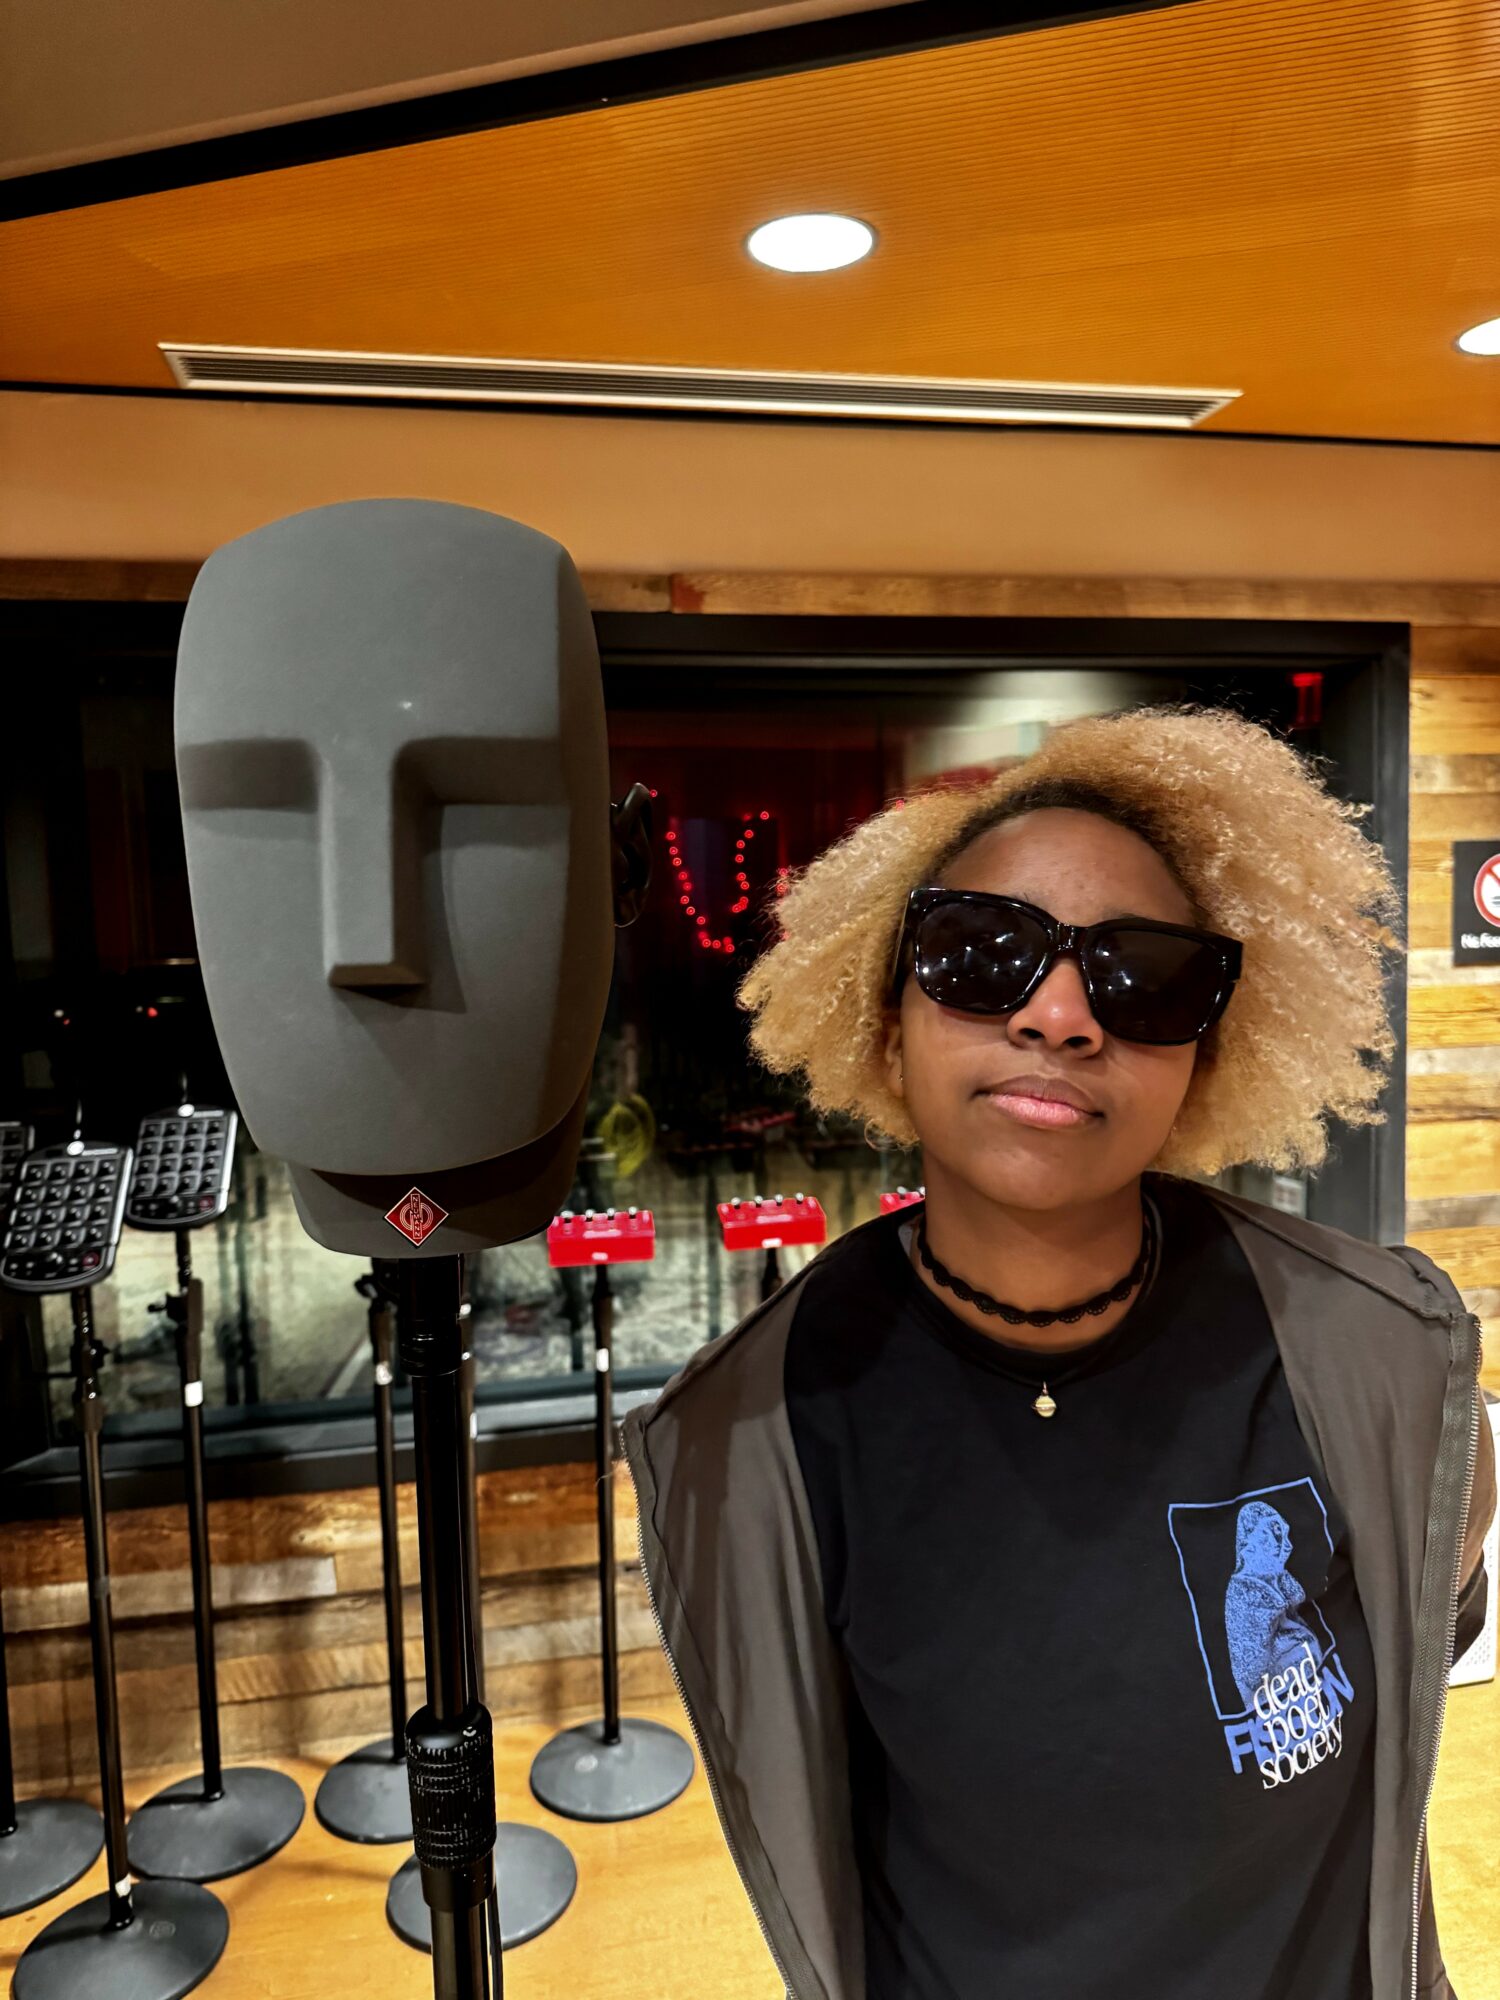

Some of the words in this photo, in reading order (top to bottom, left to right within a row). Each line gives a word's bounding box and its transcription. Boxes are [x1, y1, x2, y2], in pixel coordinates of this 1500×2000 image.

[1461, 933, 1480, 949] No
[412, 1196, 421, 1237] NEUMANN
[1253, 1641, 1322, 1720] dead
[1260, 1711, 1343, 1789] society
[1264, 1687, 1330, 1756] poet
